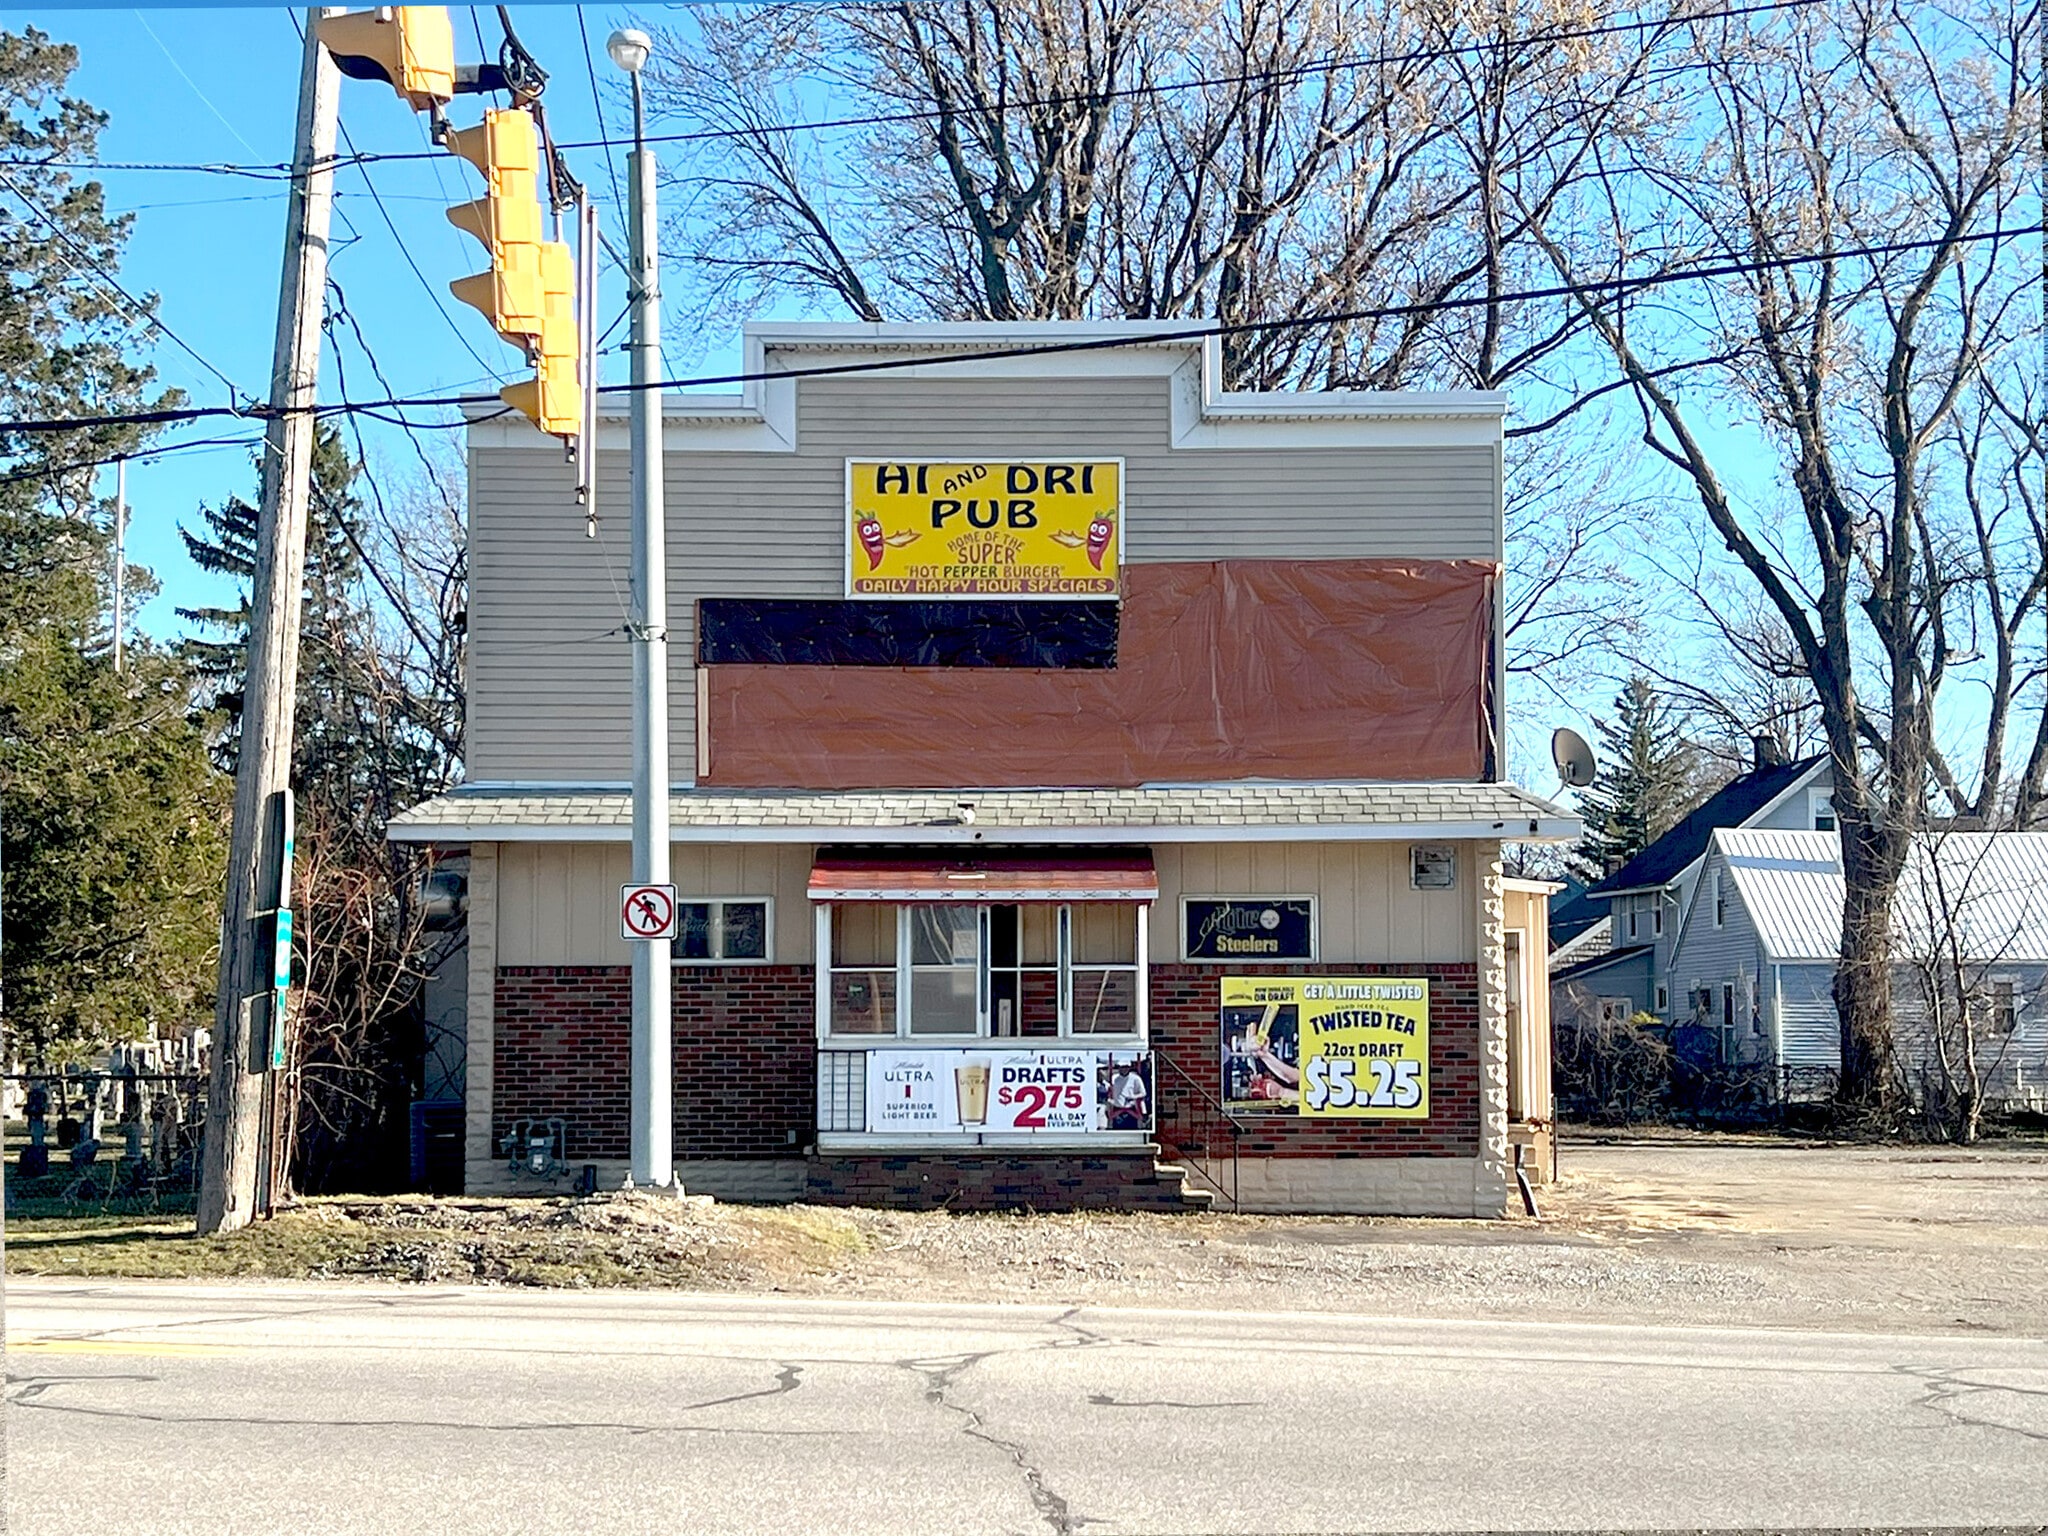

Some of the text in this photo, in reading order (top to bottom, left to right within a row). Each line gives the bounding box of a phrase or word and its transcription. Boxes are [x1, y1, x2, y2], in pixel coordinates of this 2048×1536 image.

[877, 464, 1094, 494] HI AND DRI
[932, 500, 1037, 528] PUB
[947, 531, 1026, 552] HOME OF THE
[958, 543, 1016, 564] SUPER
[944, 565, 997, 578] PEPPER
[863, 579, 1108, 592] DAILY HAPPY HOUR SPECIALS
[1216, 935, 1279, 953] Steelers
[1268, 992, 1295, 1002] DRAFT
[1304, 984, 1424, 1000] GET A LITTLE TWISTED
[1309, 1011, 1416, 1036] TWISTED TEA
[1324, 1043, 1404, 1057] 22oz DRAFT
[1047, 1056, 1083, 1064] ULTRA
[884, 1071, 934, 1082] ULTRA
[1002, 1067, 1086, 1083] DRAFTS
[1305, 1055, 1422, 1111] $5.25
